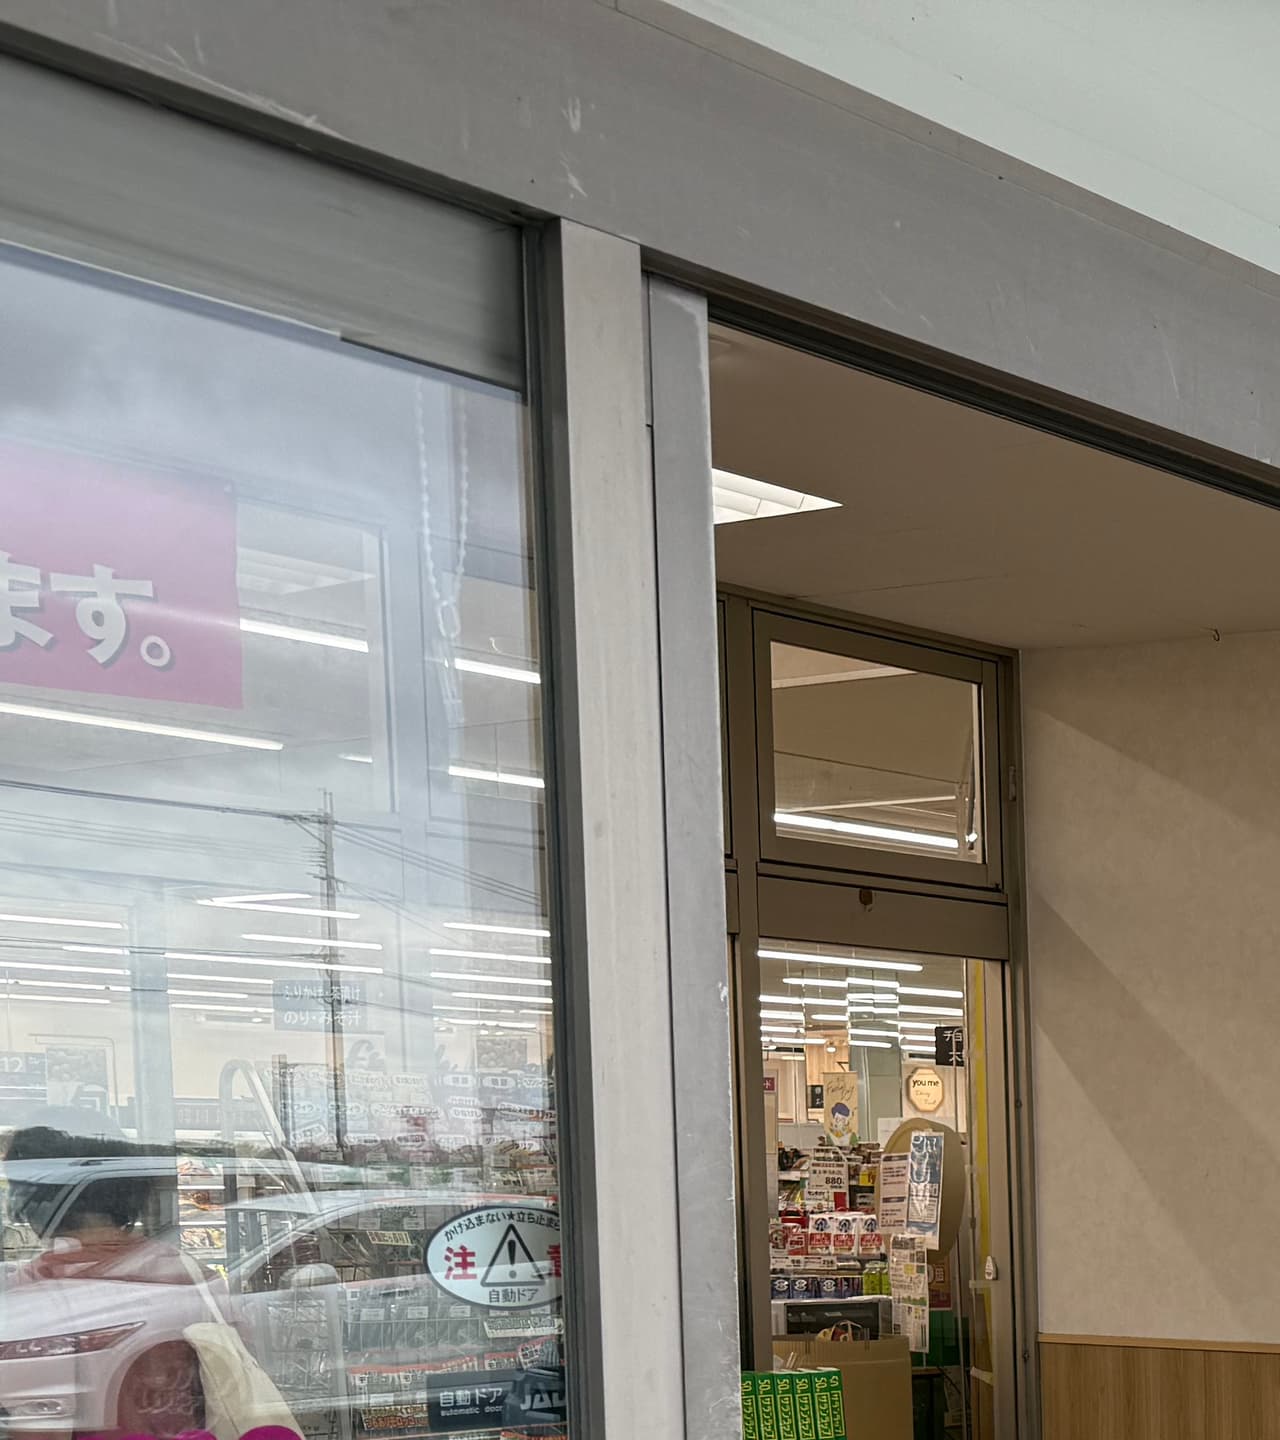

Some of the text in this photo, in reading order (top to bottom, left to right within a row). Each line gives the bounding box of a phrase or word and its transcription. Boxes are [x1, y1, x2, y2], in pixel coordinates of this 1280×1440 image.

[488, 1288, 539, 1304] 自動ドア
[439, 1387, 503, 1408] 自動ドア
